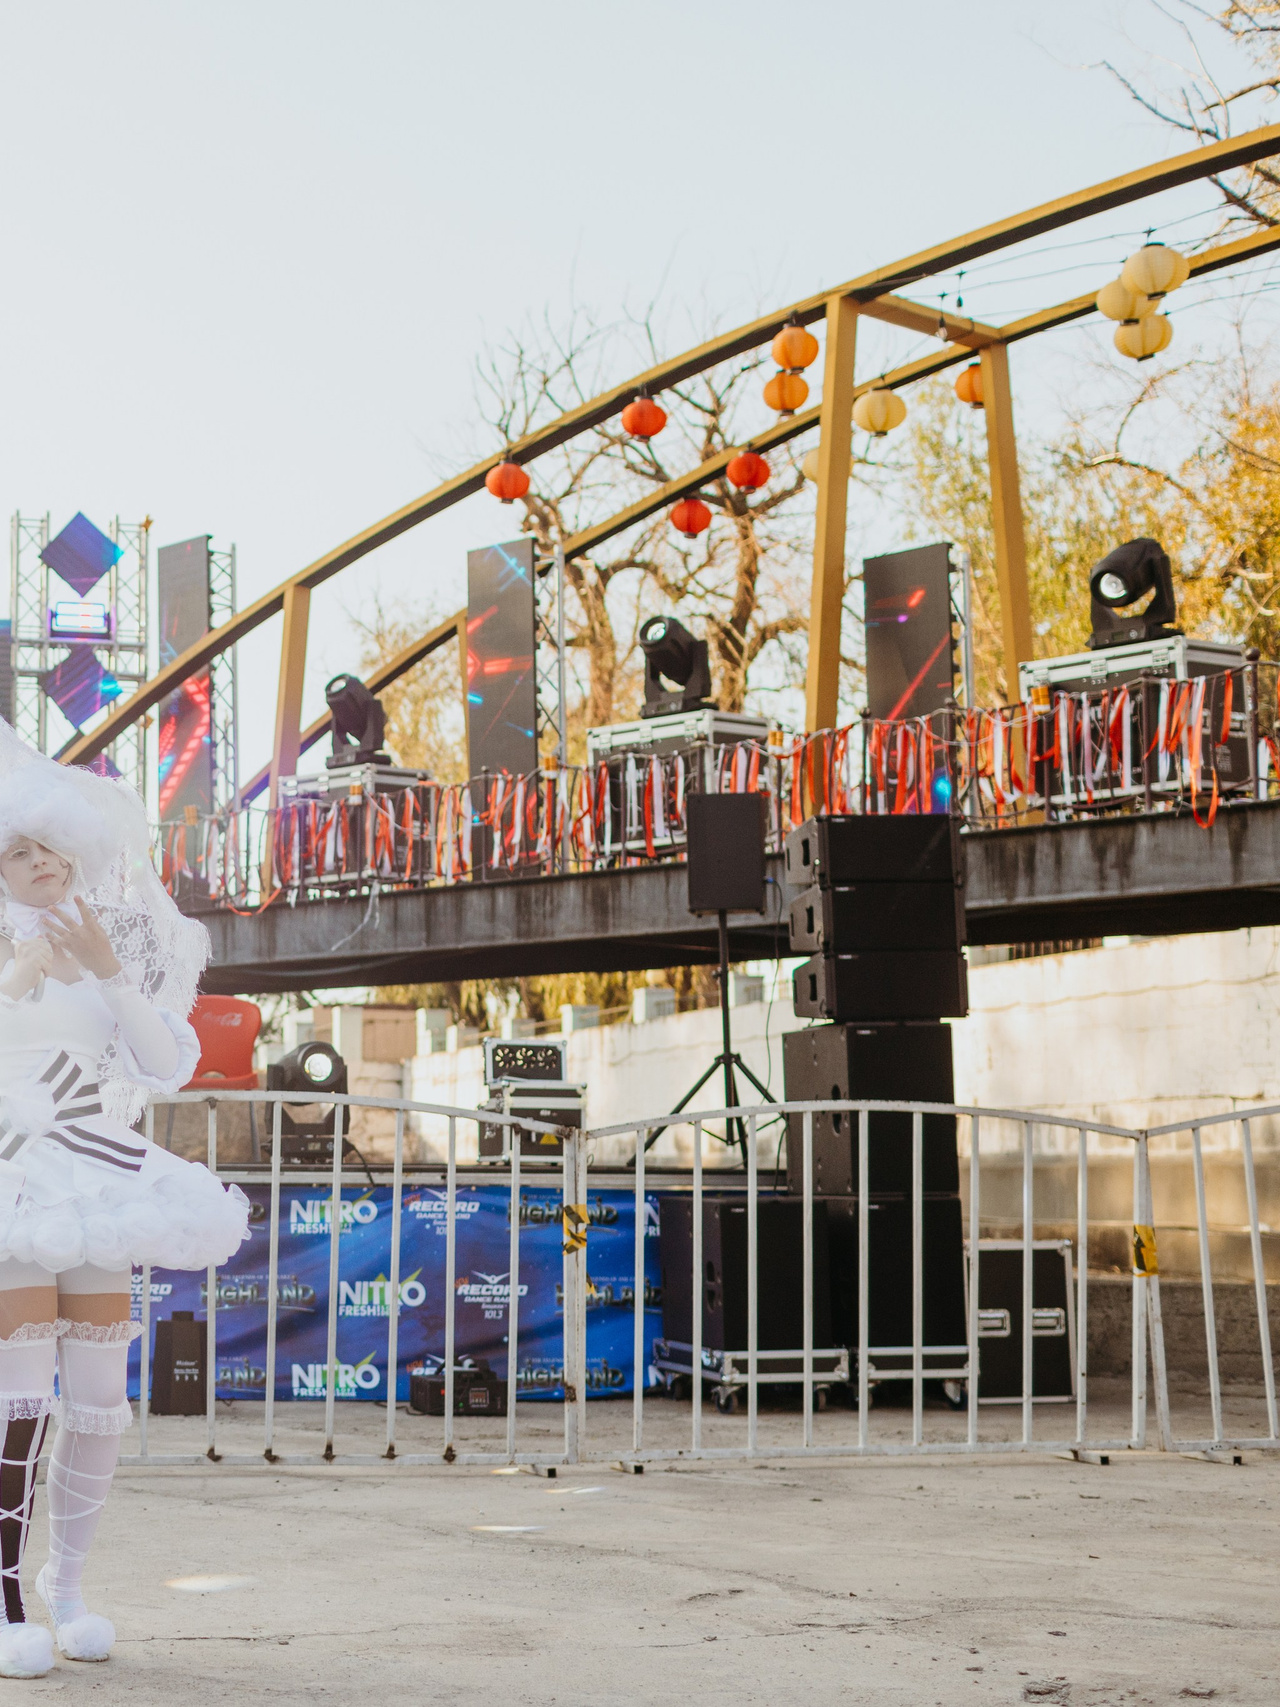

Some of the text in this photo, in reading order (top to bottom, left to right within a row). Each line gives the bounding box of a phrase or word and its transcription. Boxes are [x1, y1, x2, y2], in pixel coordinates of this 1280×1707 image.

[290, 1200, 378, 1224] NITRO
[408, 1201, 480, 1212] RECRD
[485, 1310, 503, 1319] 101.3
